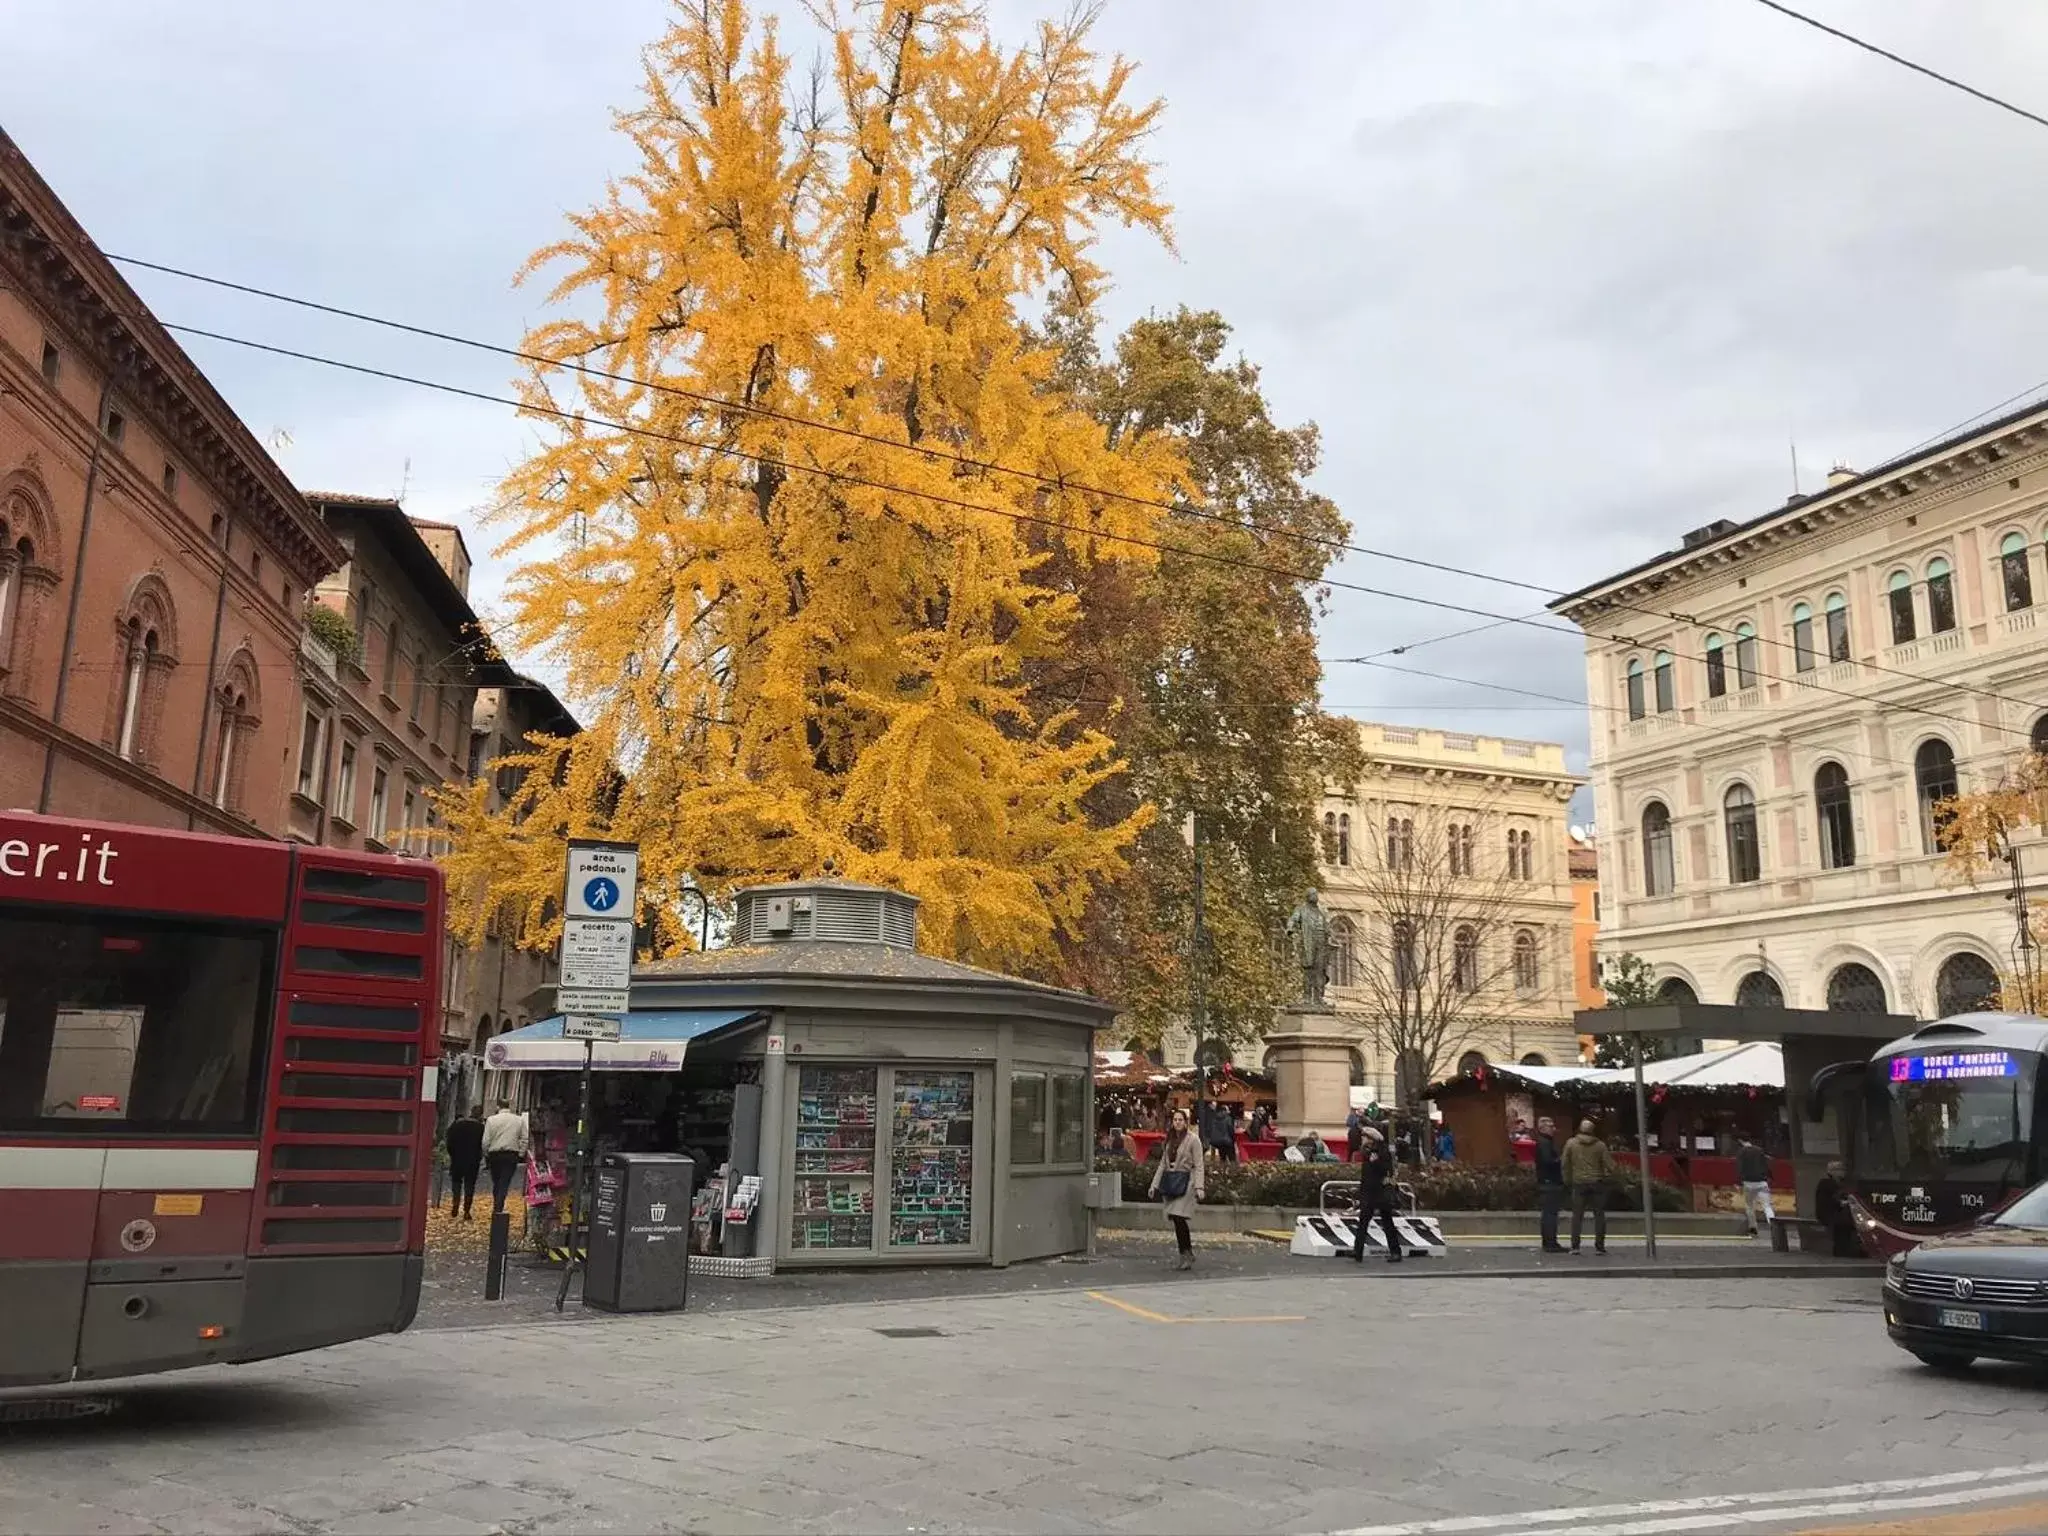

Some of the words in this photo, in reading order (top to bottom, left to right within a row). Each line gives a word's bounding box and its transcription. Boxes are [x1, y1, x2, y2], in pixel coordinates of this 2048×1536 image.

[0, 833, 118, 886] er.it
[592, 854, 615, 863] area
[579, 863, 626, 874] pedonale
[581, 923, 615, 932] eccetto
[1923, 1056, 1955, 1068] BORGO
[1958, 1052, 2009, 1066] PANIGALE
[1924, 1068, 1942, 1079] VIA
[1946, 1065, 2005, 1079] NORMANDIA
[1960, 1194, 1984, 1207] 1104
